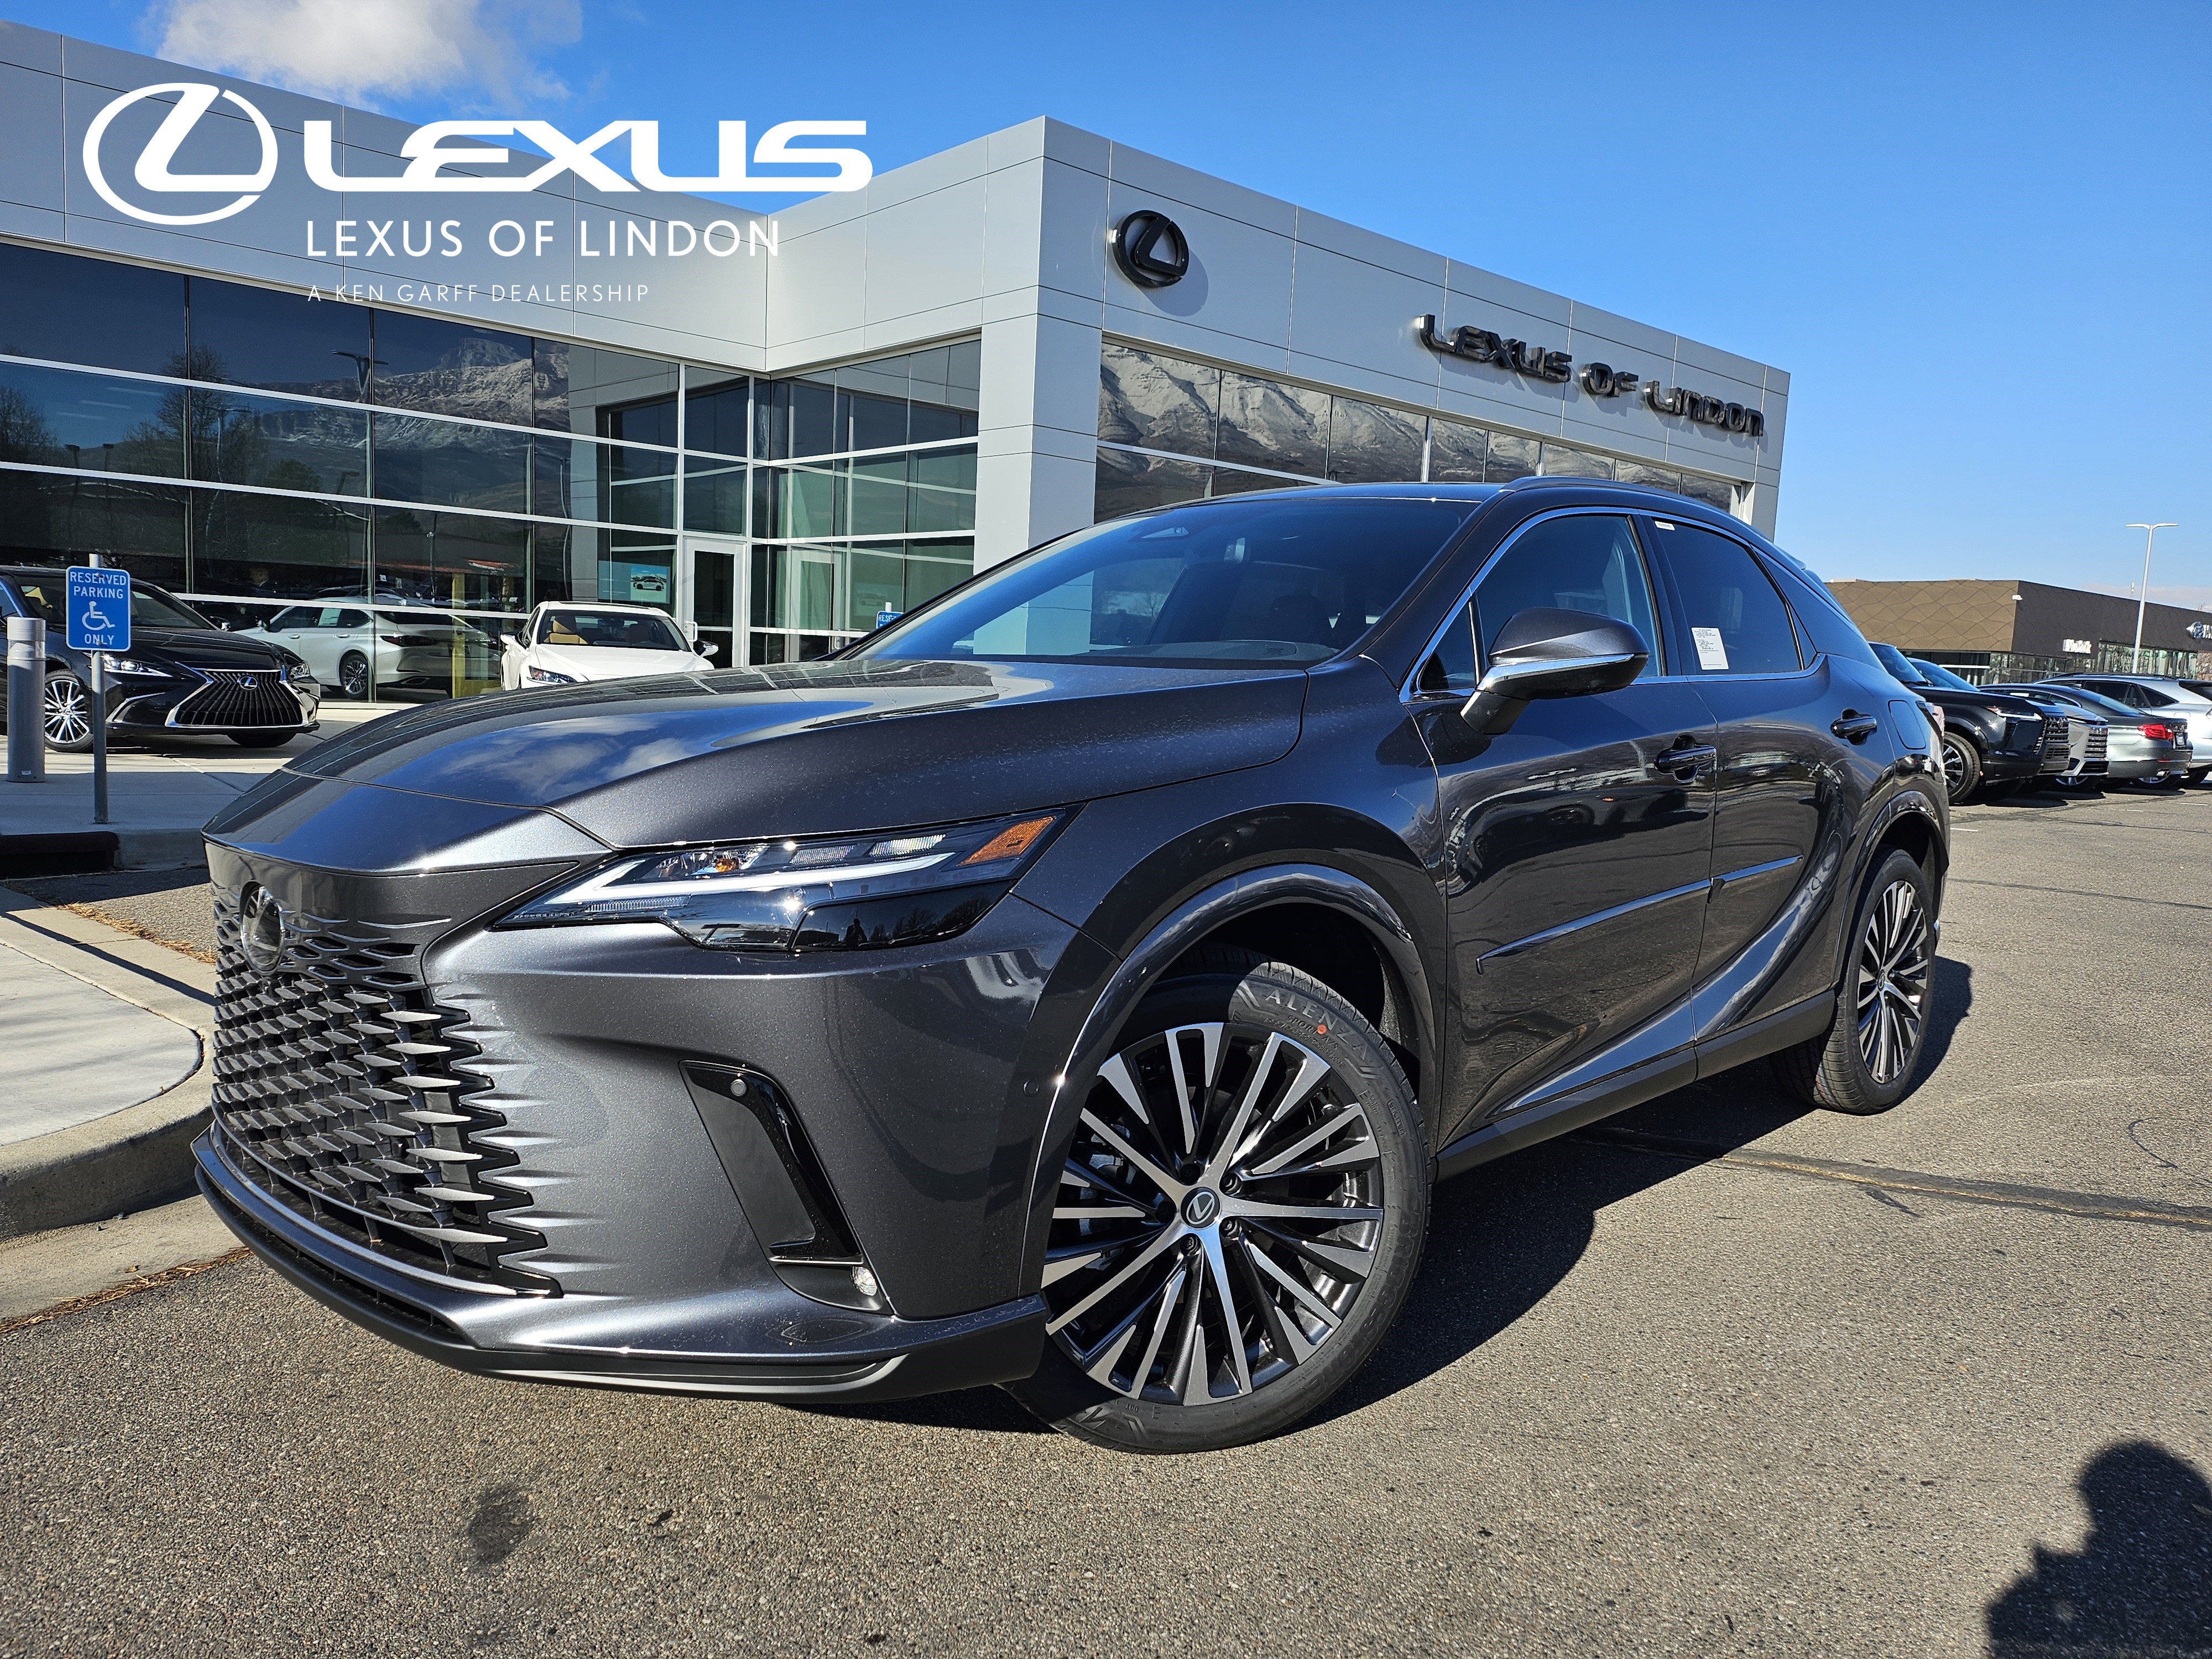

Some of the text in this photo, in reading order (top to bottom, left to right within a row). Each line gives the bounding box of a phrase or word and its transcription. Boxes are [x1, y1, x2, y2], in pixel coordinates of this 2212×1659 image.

[1419, 314, 1765, 437] LEXUS OF LINDON
[70, 571, 127, 586] RESERVED
[74, 586, 124, 599] PARKING
[84, 633, 114, 645] ONLY
[1265, 989, 1368, 1061] ALENZA
